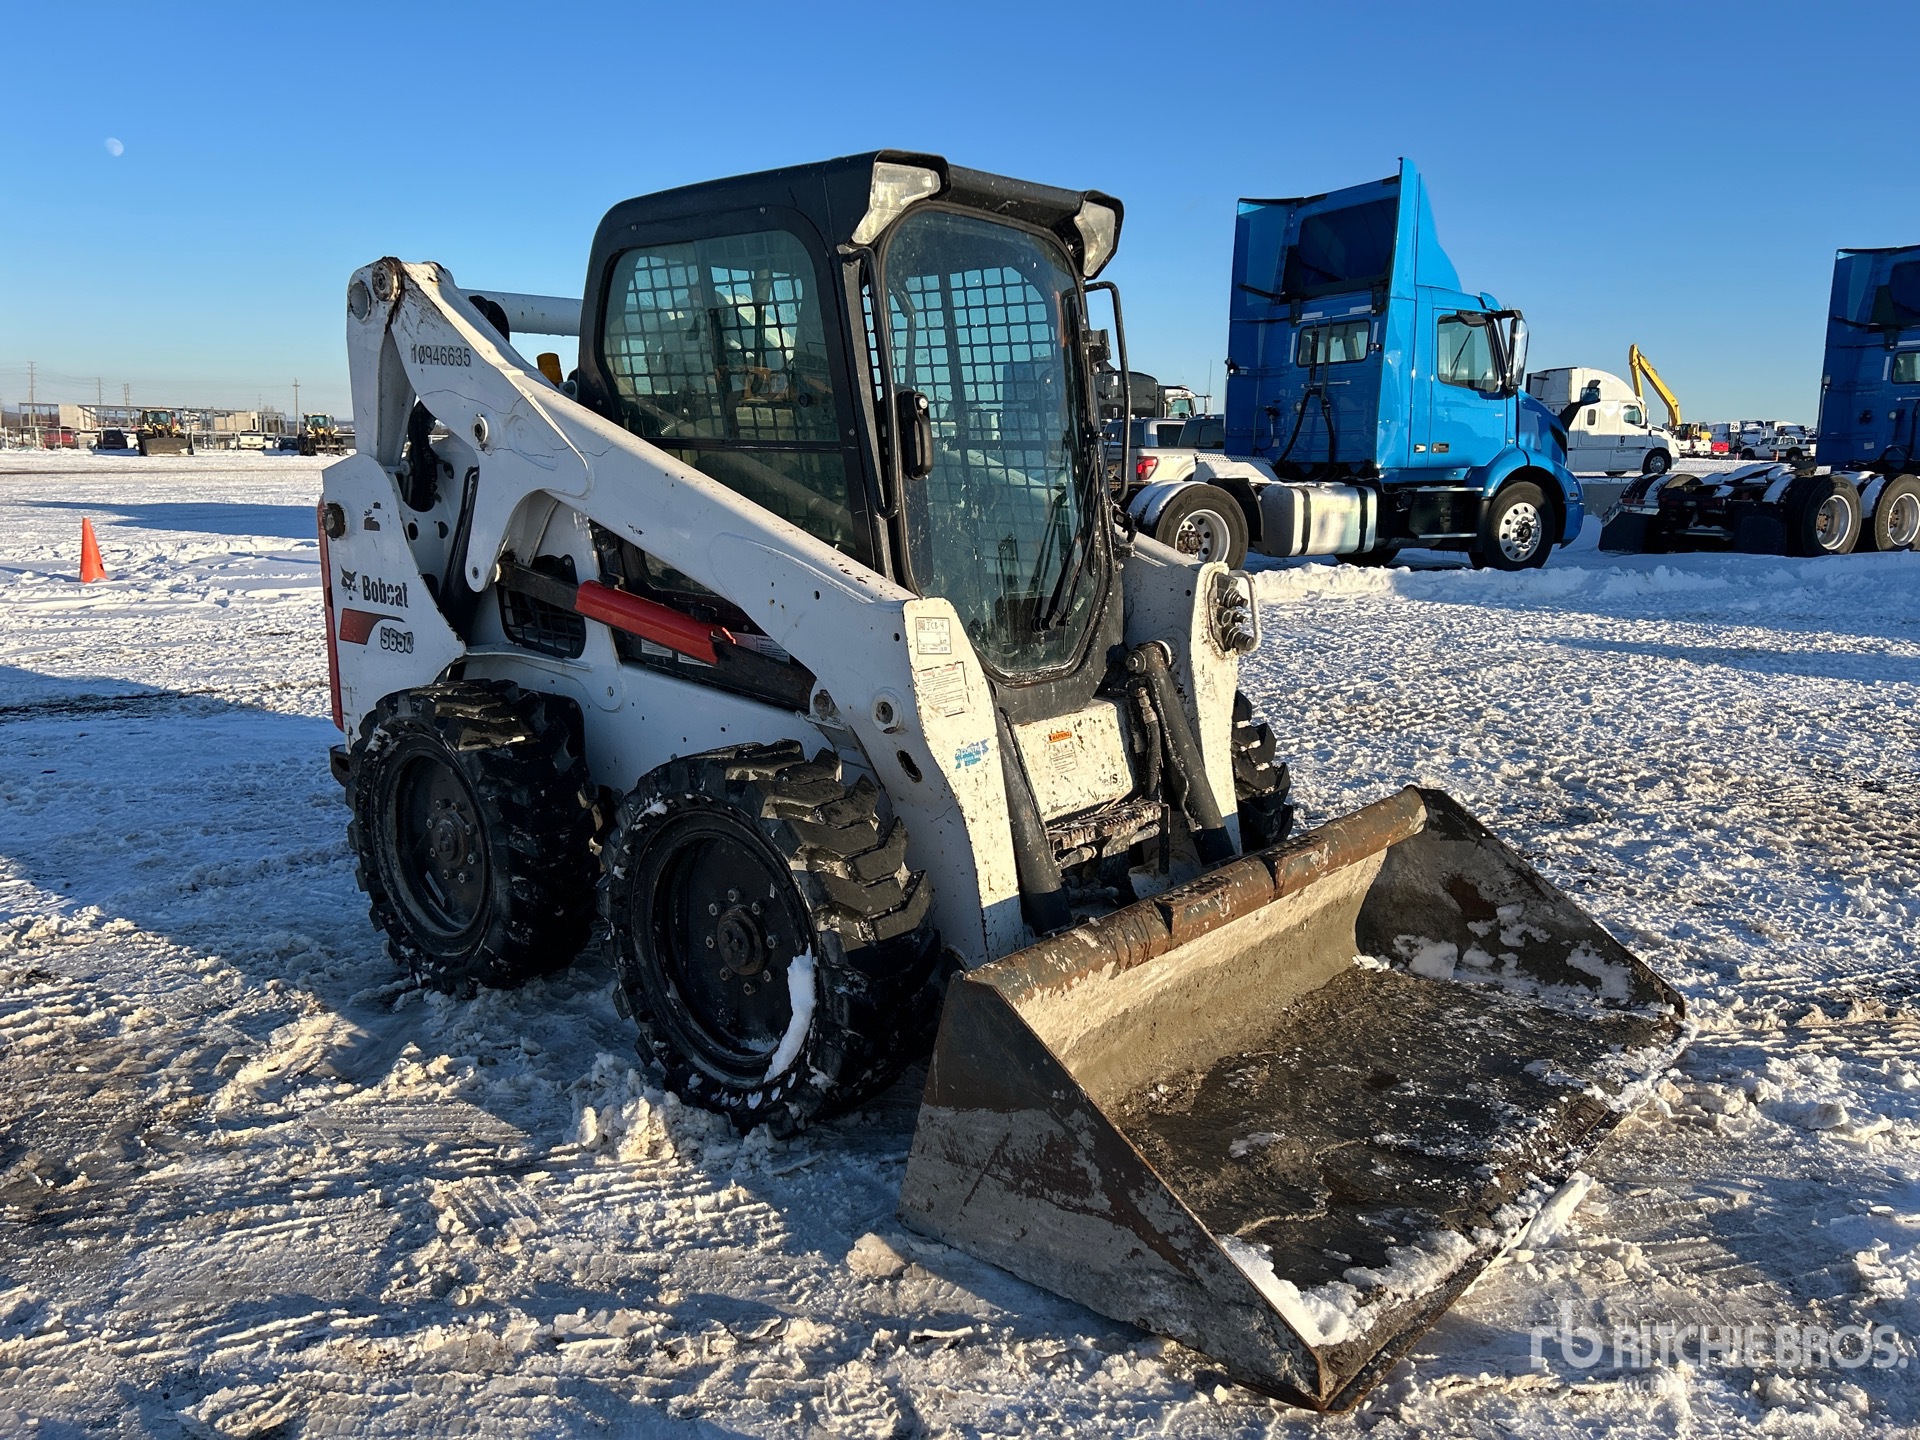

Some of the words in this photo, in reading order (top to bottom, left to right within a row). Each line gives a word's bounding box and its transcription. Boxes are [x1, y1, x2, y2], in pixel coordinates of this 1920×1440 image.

[410, 343, 472, 367] 10946635
[361, 574, 409, 608] Bobcat
[380, 626, 415, 654] S650
